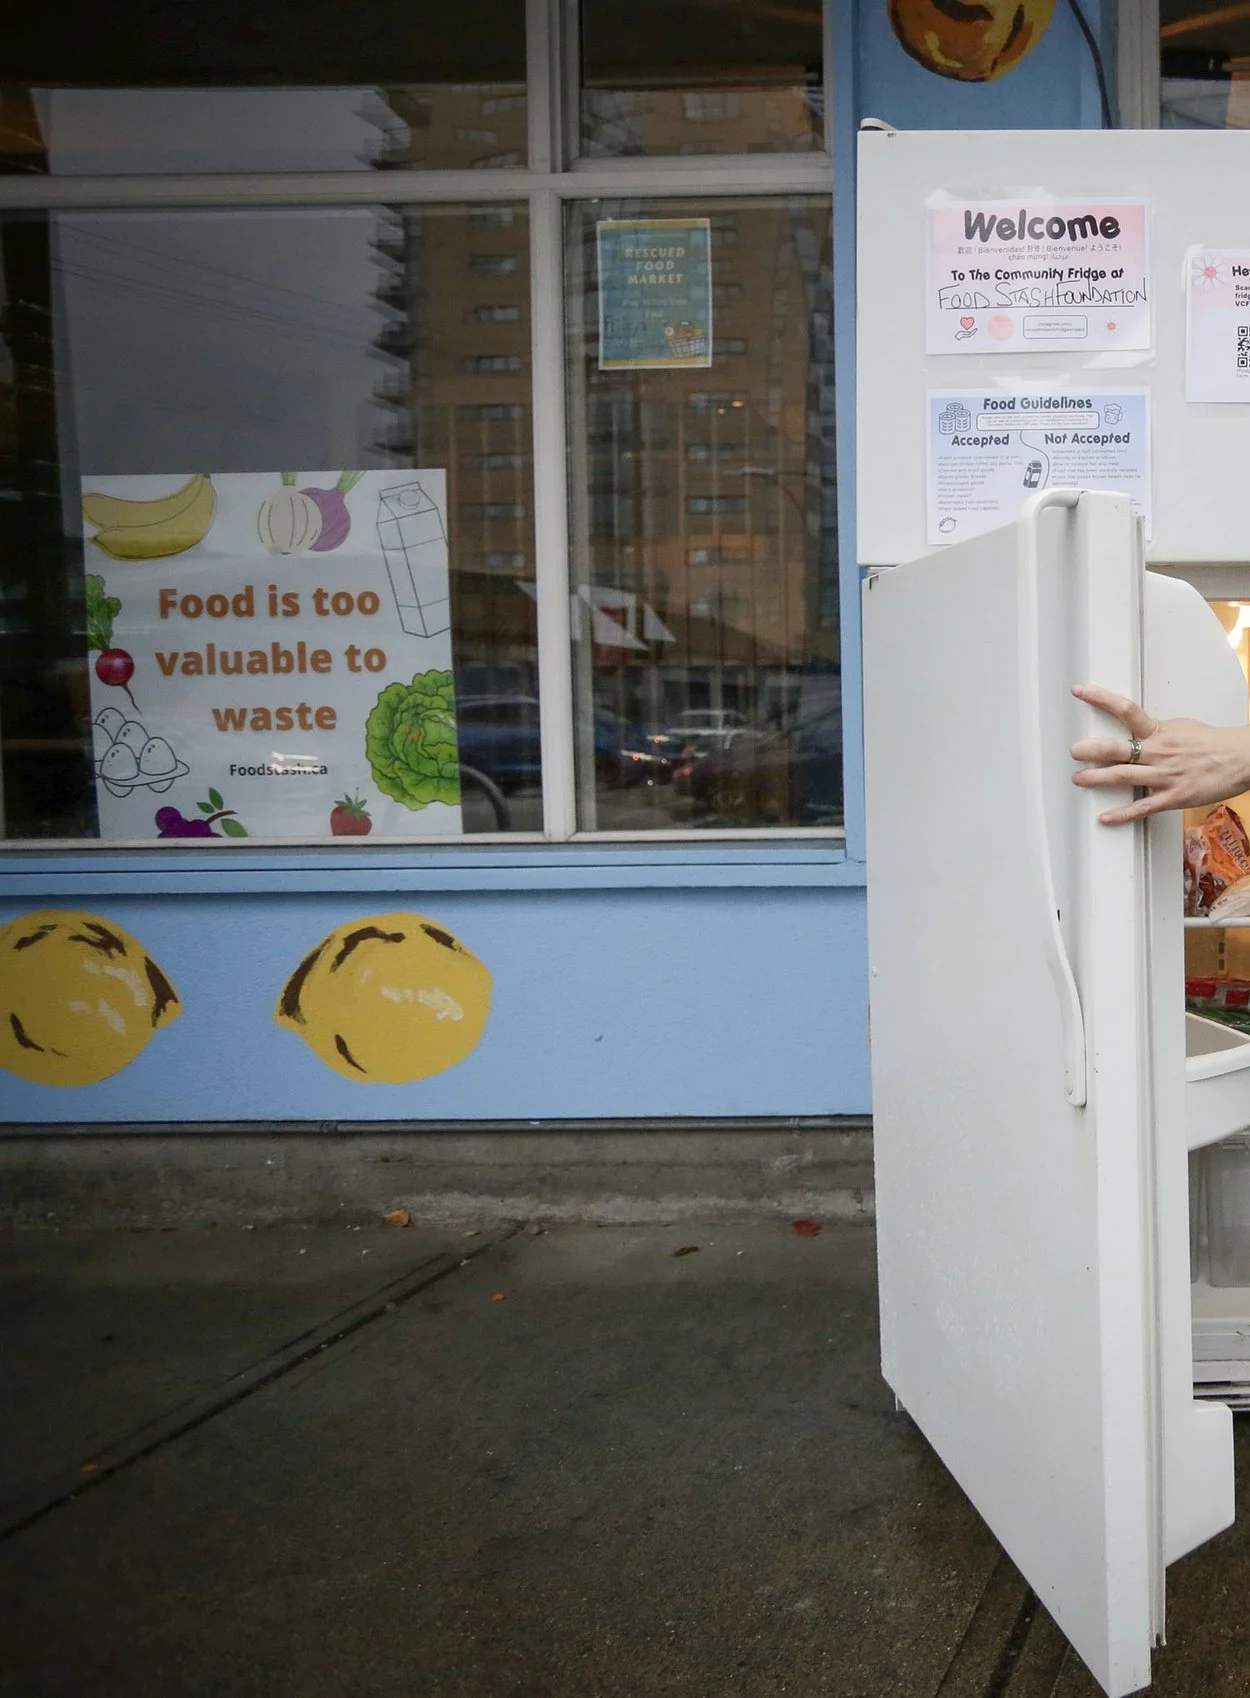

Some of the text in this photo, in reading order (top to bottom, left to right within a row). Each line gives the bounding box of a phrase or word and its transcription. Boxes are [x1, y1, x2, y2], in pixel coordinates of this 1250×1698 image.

[963, 208, 1121, 243] Welcome
[624, 247, 685, 259] RESCUED
[1046, 244, 1088, 252] Bienvenue!
[635, 260, 675, 272] FOOD
[627, 273, 684, 285] MARKET
[951, 267, 1125, 282] To The Community Fridge at
[938, 277, 1148, 310] FOOD STASH FOUNDATION
[983, 395, 1093, 411] Food Guidelines
[951, 434, 1010, 448] Accepted
[1044, 432, 1131, 448] Not Accepted
[158, 584, 381, 619] Food is too
[154, 641, 388, 677] valuable to
[211, 702, 338, 733] waste
